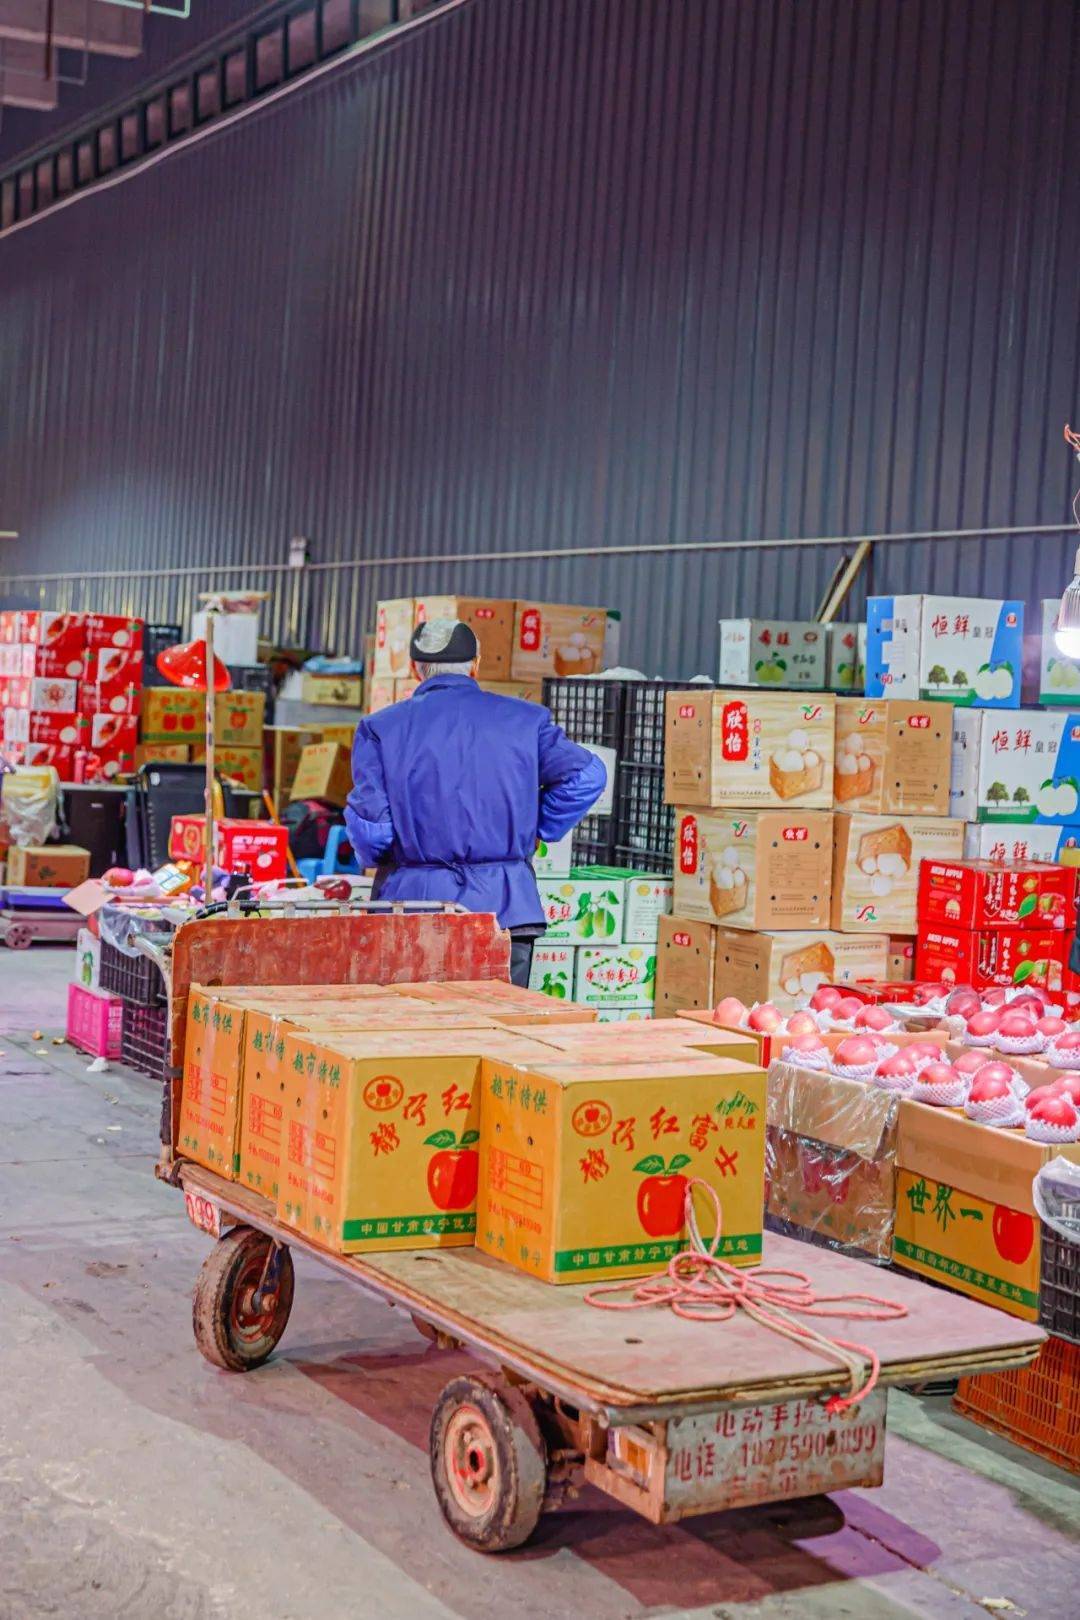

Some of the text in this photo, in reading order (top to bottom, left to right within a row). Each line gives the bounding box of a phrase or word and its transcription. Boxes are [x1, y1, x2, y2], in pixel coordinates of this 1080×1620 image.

[931, 614, 970, 641] 恒鲜
[725, 710, 744, 753] 欣怡
[991, 728, 1058, 756] 恒鲜 皇冠
[292, 1049, 341, 1089] 超市特供
[490, 1073, 548, 1116] 超市特供
[907, 1178, 984, 1232] 世界一
[674, 1441, 716, 1482] 电话
